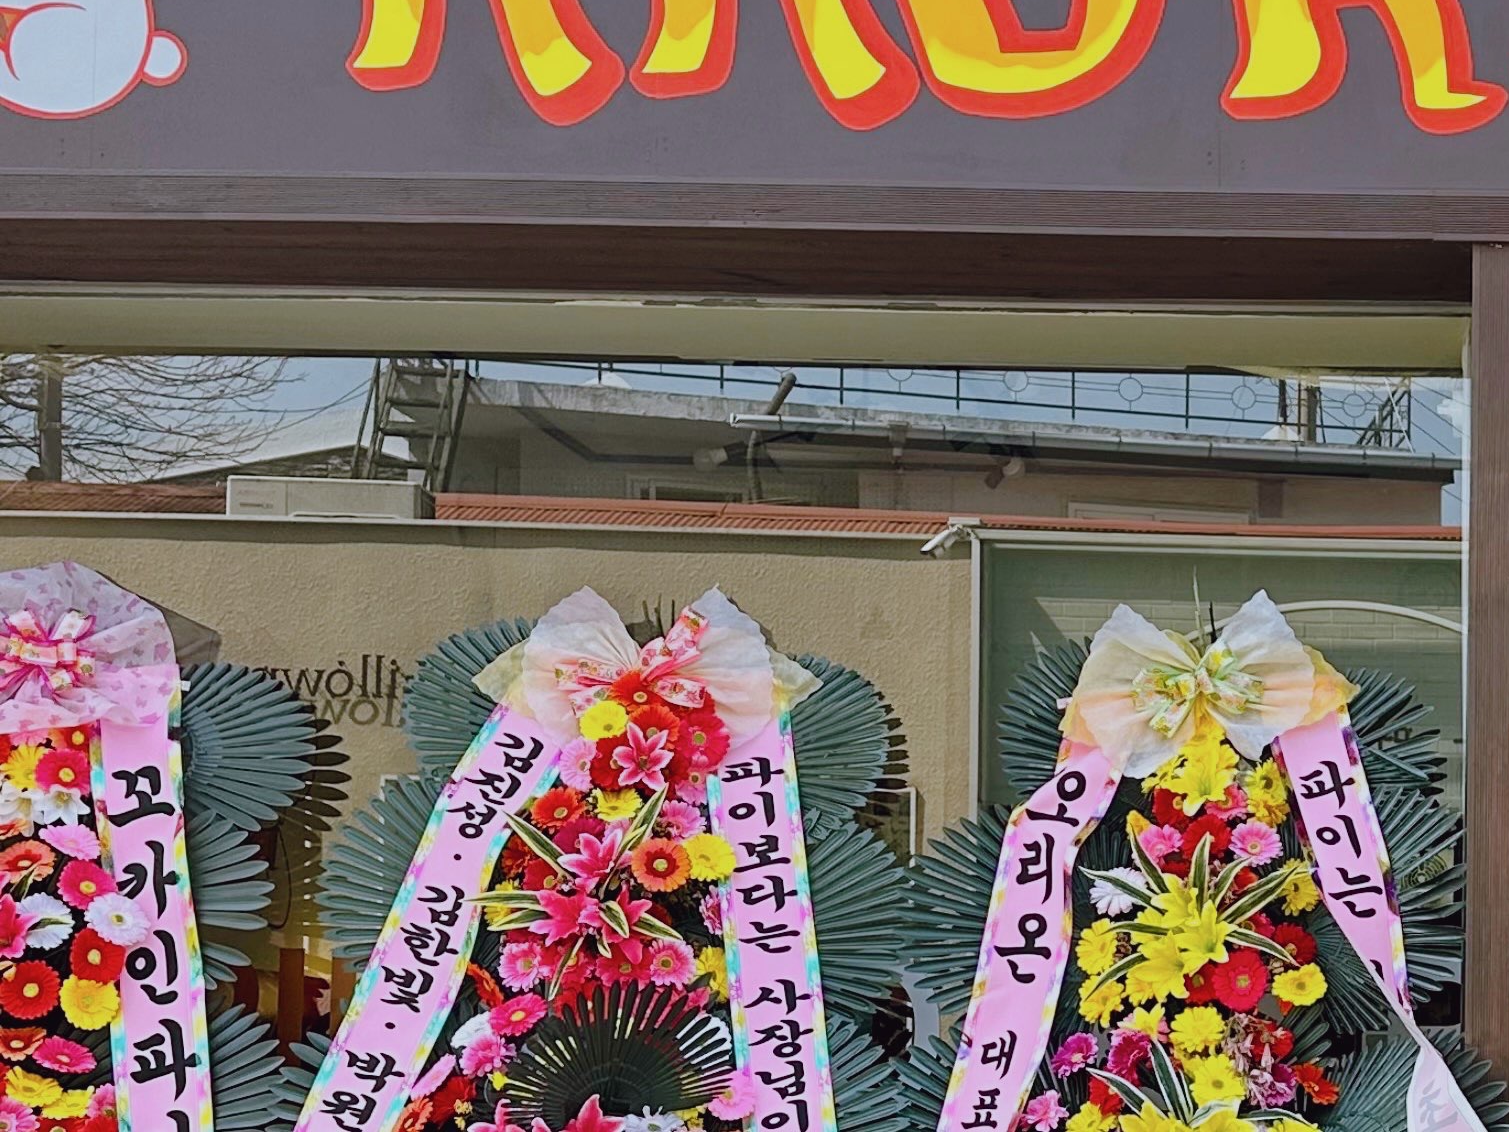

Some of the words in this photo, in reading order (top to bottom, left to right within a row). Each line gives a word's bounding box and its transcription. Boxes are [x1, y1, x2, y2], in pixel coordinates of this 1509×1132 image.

[721, 756, 801, 954] 파이보다는
[994, 770, 1086, 984] 오리온
[1299, 760, 1383, 918] 파이는
[743, 978, 815, 1132] 사장님이
[961, 1030, 1018, 1129] 대표
